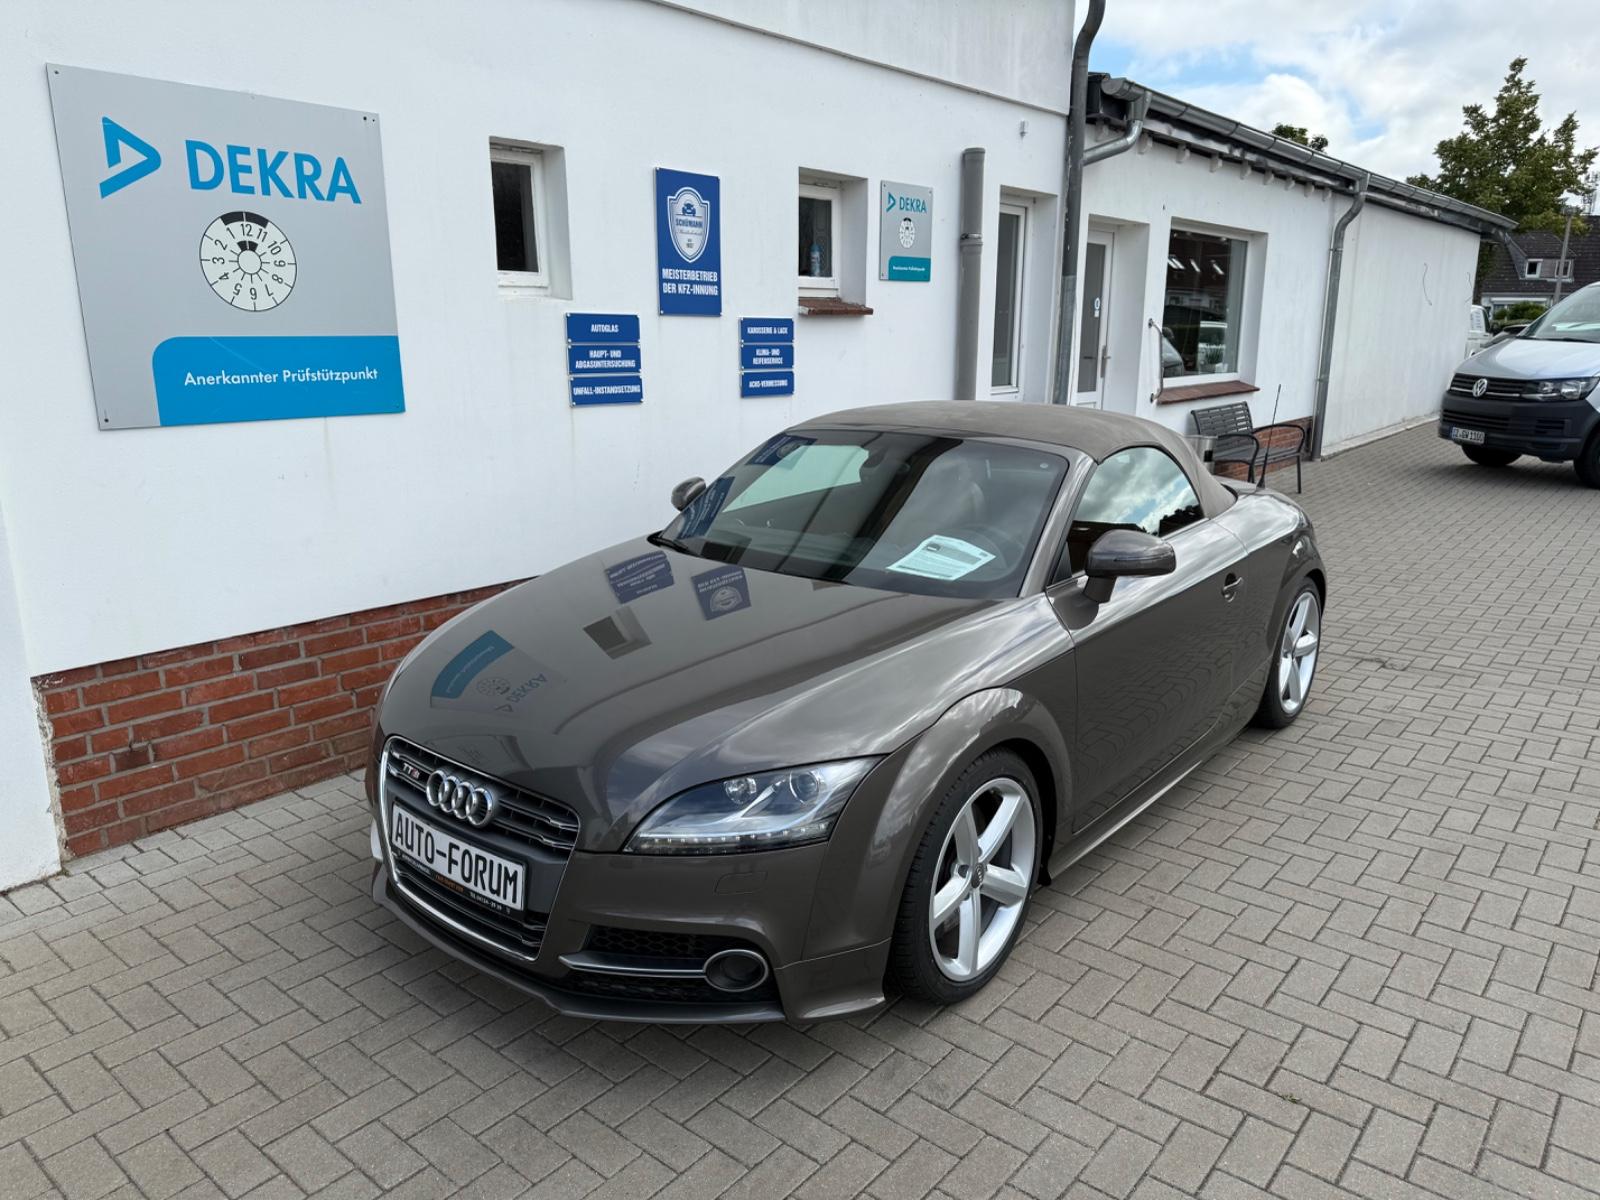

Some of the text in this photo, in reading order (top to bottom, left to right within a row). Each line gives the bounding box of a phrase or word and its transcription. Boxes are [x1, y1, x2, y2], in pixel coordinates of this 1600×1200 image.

[185, 139, 362, 205] DEKRA
[899, 197, 927, 214] DEKRA
[212, 223, 286, 300] 12 11 10 9 8 7 6 5 4 3 2 1
[662, 268, 718, 282] MEISTERBETRIEB
[662, 282, 718, 296] DER KFZ-INNUNG
[590, 324, 619, 333] AUTOGLAS
[589, 349, 622, 358] HAUPT- UND
[575, 360, 636, 369] ABGASUNTERSUCHUNG
[184, 367, 378, 387] Anerkannter Prüfstützpunkt
[395, 813, 518, 904] AUTO-FORUM
